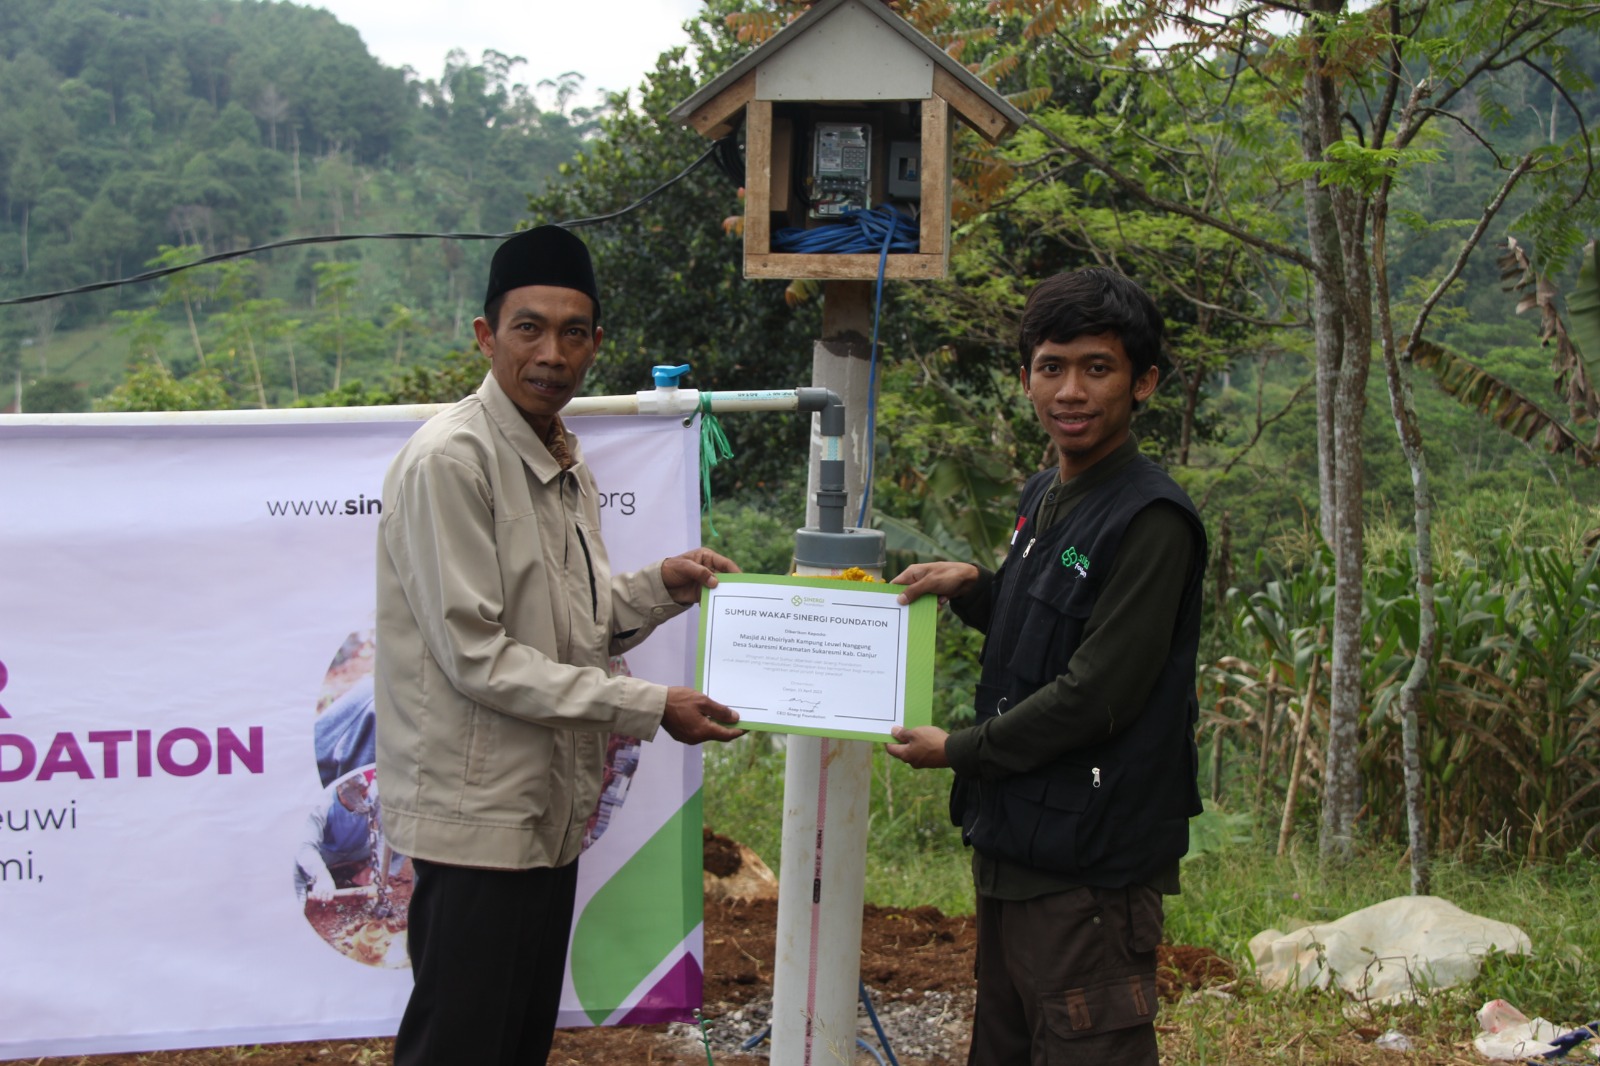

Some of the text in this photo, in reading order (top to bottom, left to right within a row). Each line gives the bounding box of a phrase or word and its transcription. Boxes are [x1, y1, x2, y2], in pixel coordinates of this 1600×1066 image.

[724, 608, 889, 628] SUMUR WAKAF SINERGI FOUNDATION
[768, 636, 795, 644] Khoiriyah
[796, 638, 823, 647] Kampung
[842, 642, 871, 651] Nanggung
[779, 645, 811, 653] Kecamatan
[812, 648, 842, 656] Sukaresmi
[0, 799, 76, 832] uwi
